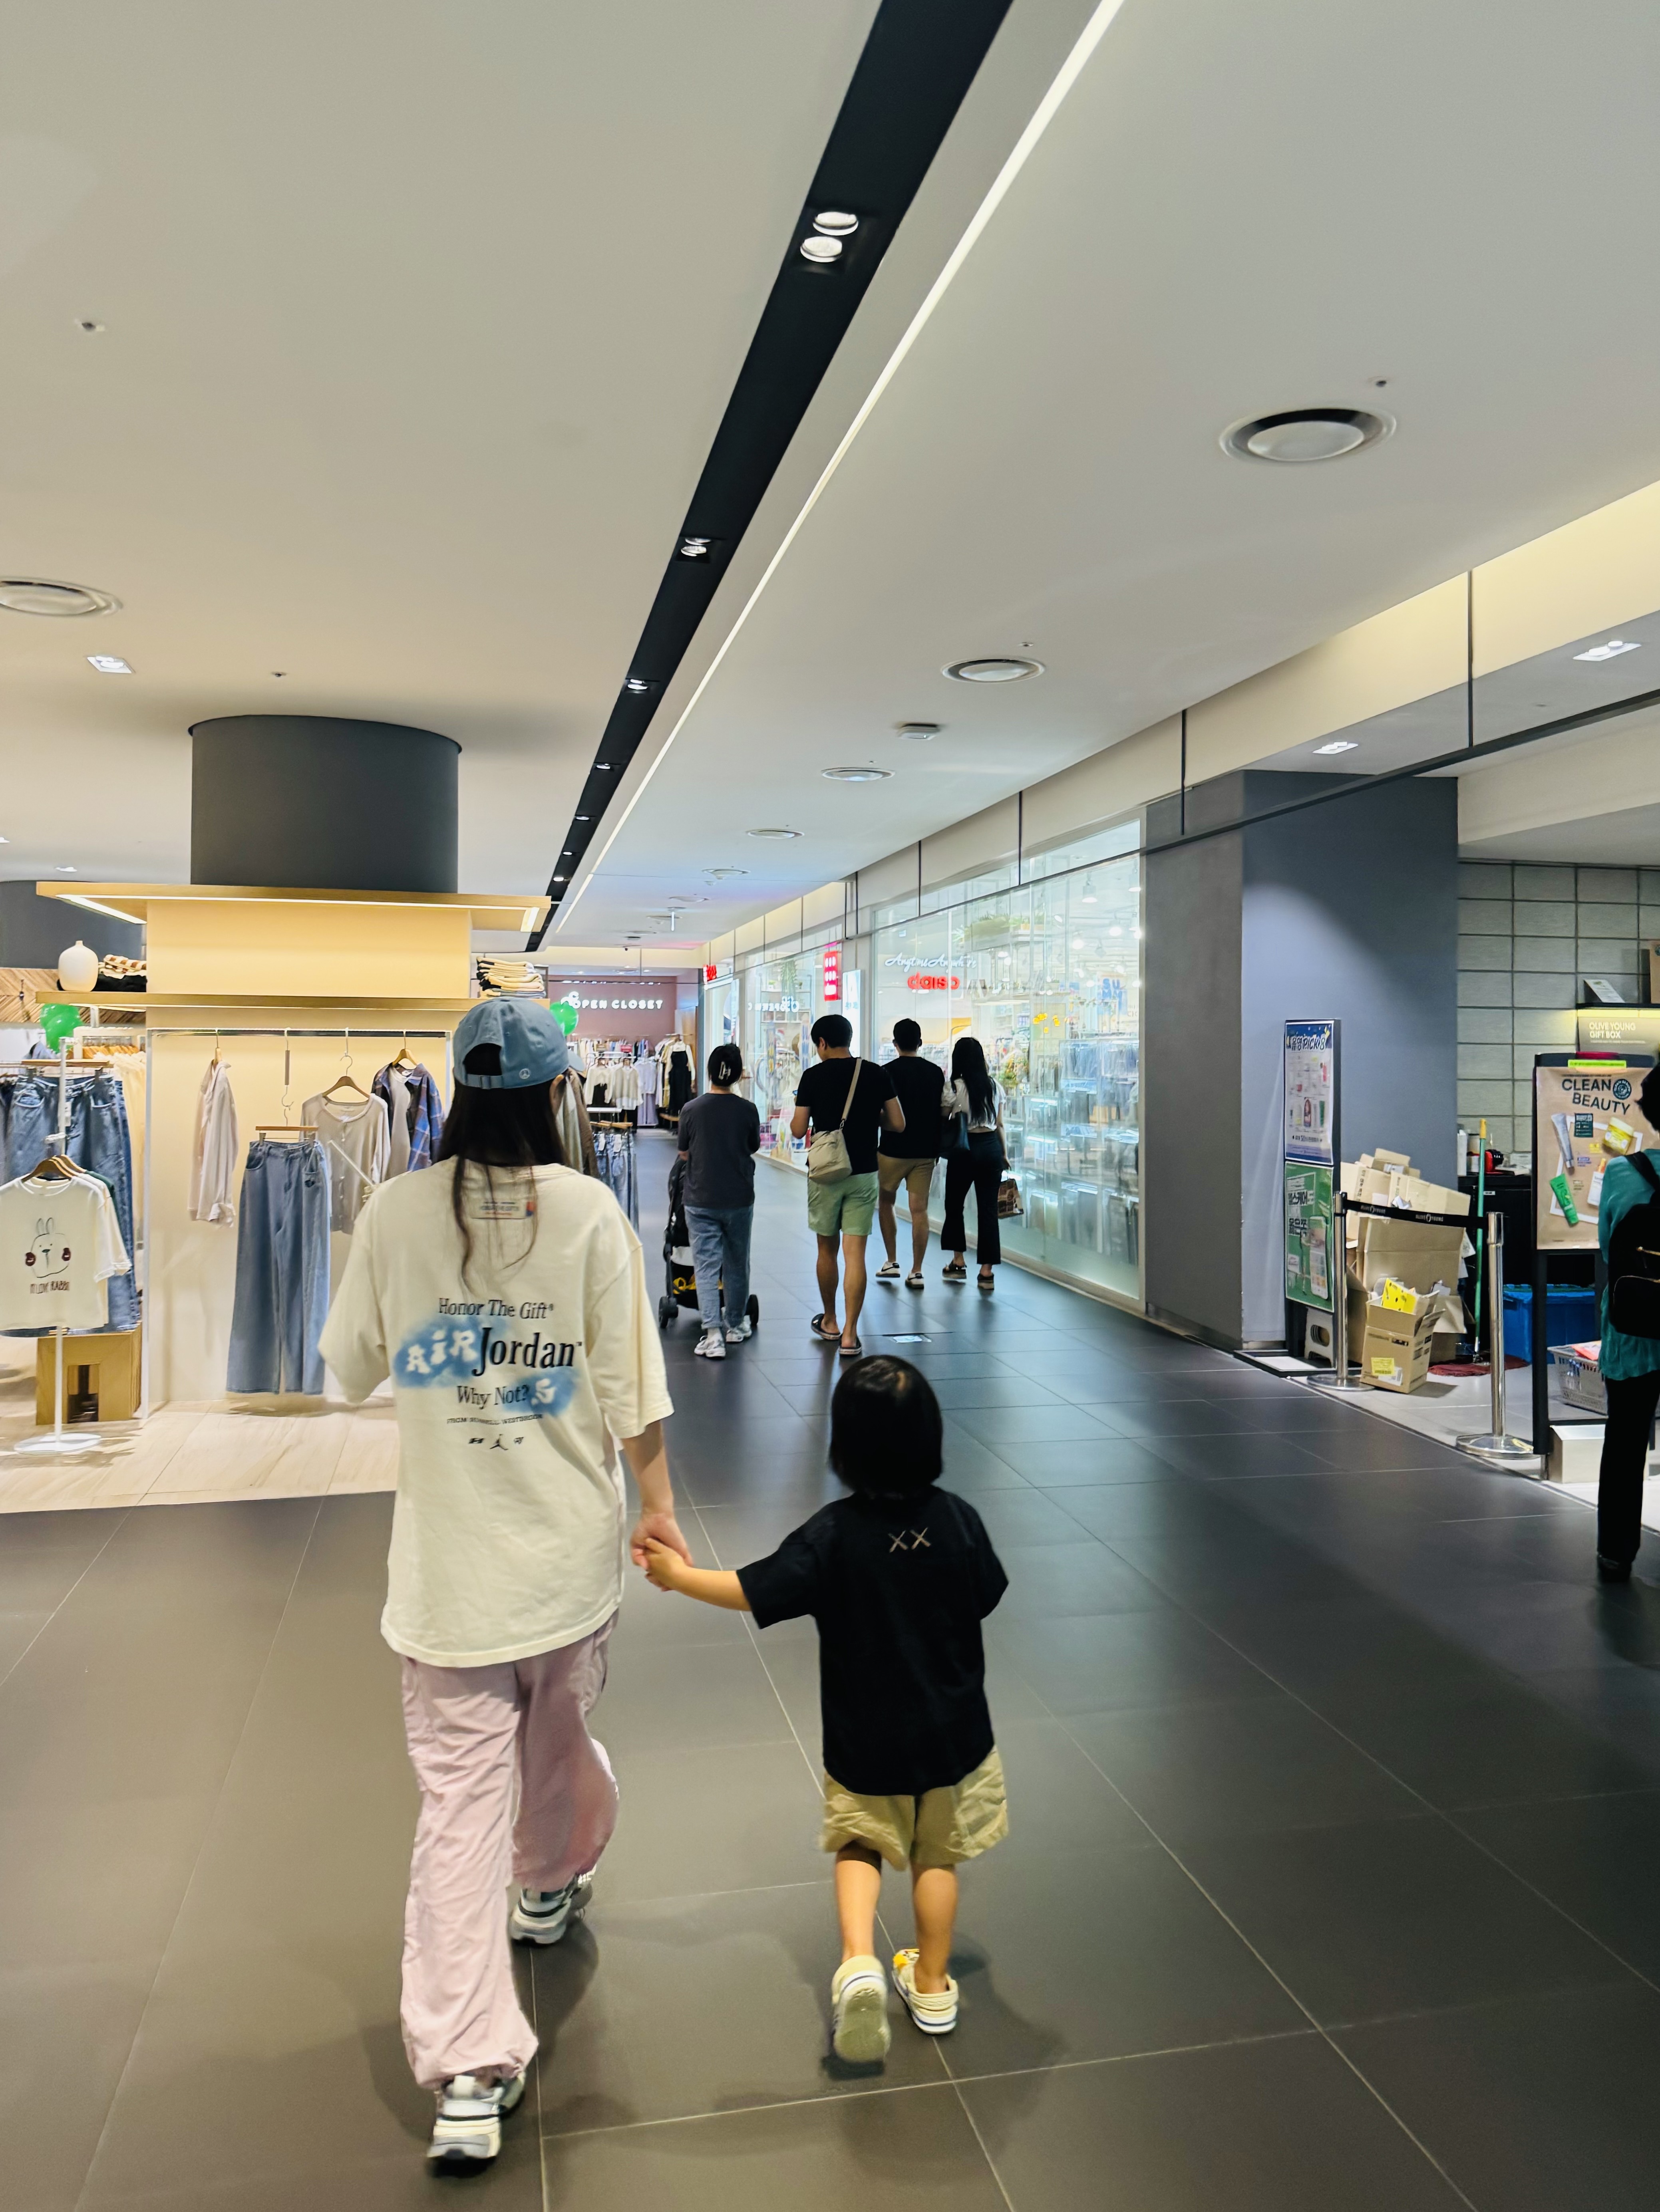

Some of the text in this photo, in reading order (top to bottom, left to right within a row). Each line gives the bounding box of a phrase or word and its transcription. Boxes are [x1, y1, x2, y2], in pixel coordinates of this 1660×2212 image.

[928, 954, 976, 973] Anywhre
[908, 972, 960, 989] daiso
[571, 1000, 663, 1009] OPEN CLOSET
[1589, 1022, 1636, 1031] OLIVE YOUNG
[1562, 1079, 1611, 1091] CLEAN
[1573, 1092, 1630, 1115] BEAUTY
[439, 1298, 484, 1316] Honor
[488, 1299, 515, 1317] The
[457, 1386, 492, 1410] Why
[494, 1384, 530, 1405] Not?
